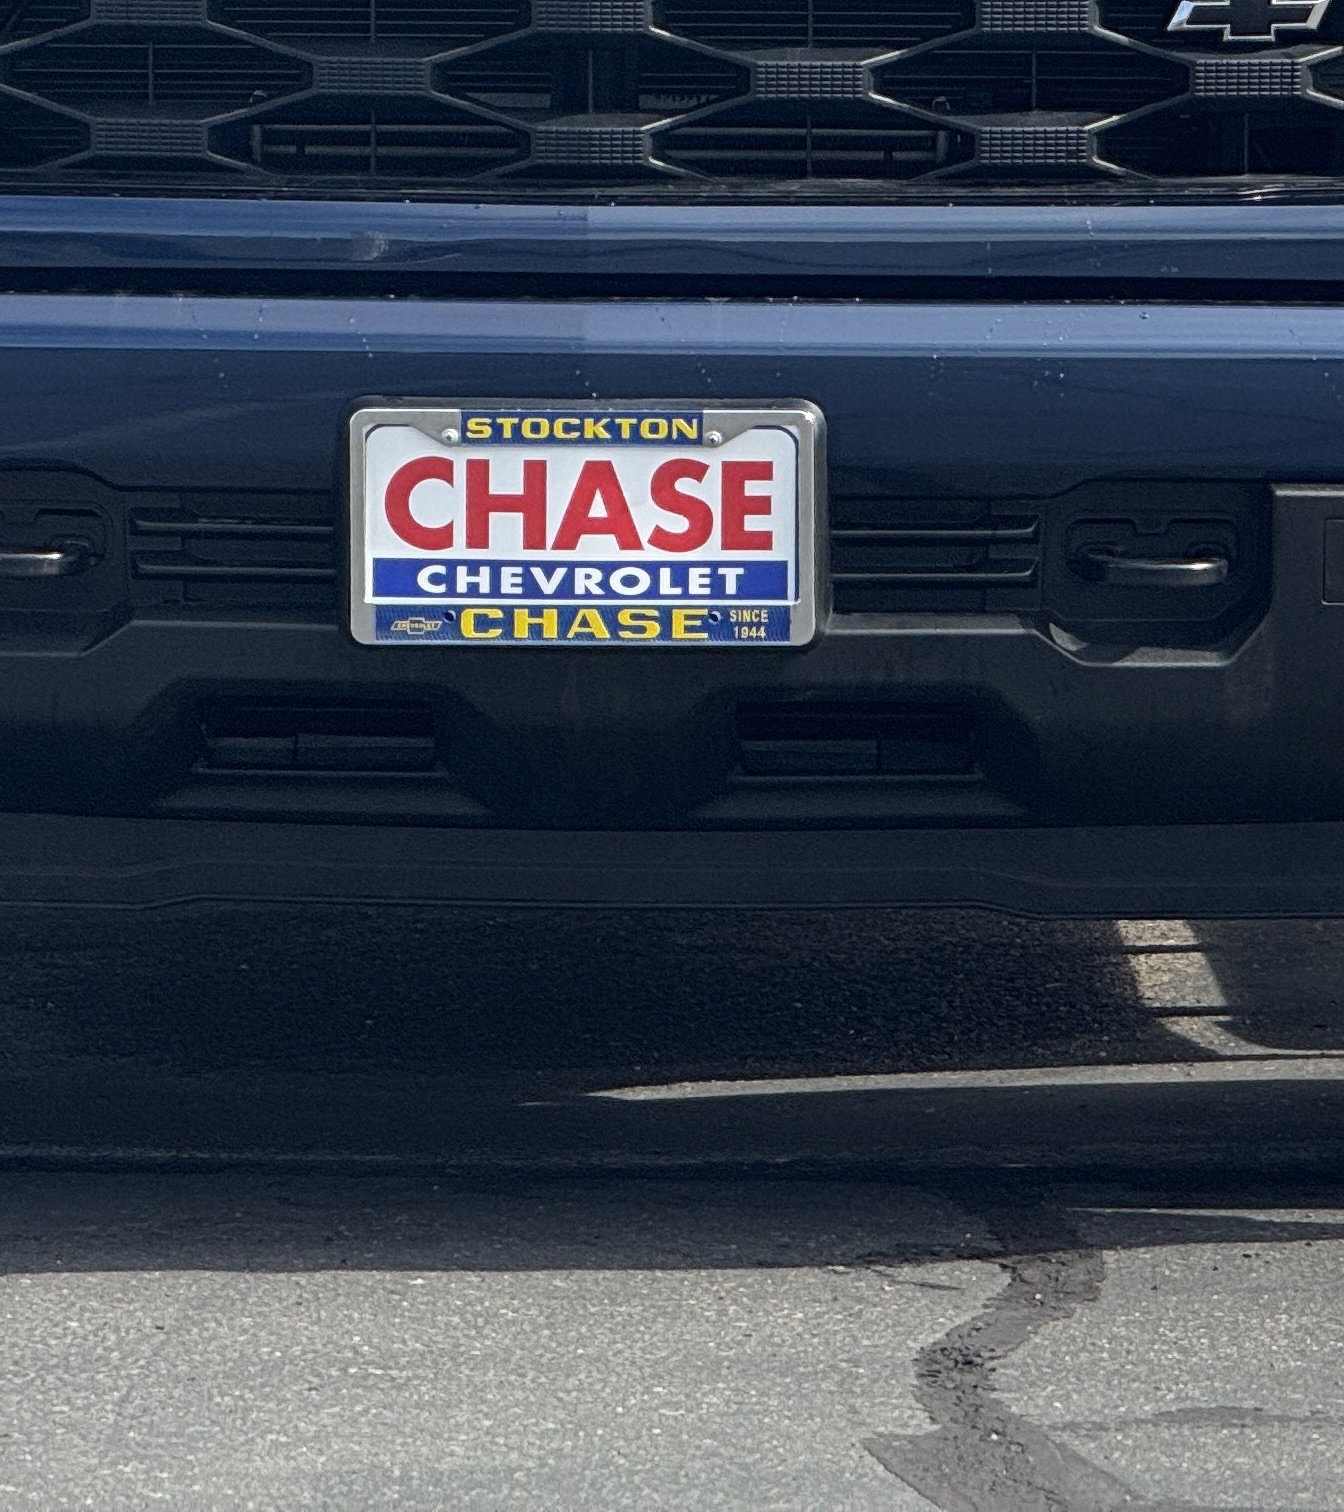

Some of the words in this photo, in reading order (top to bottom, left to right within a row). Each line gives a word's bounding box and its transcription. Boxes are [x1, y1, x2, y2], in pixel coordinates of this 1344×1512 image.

[465, 417, 698, 440] STOCKTON
[384, 456, 774, 551] CHASE
[416, 565, 745, 596] CHEVROLET
[460, 607, 709, 639] CHASE
[729, 609, 769, 623] SINCE
[733, 626, 766, 639] 1944
